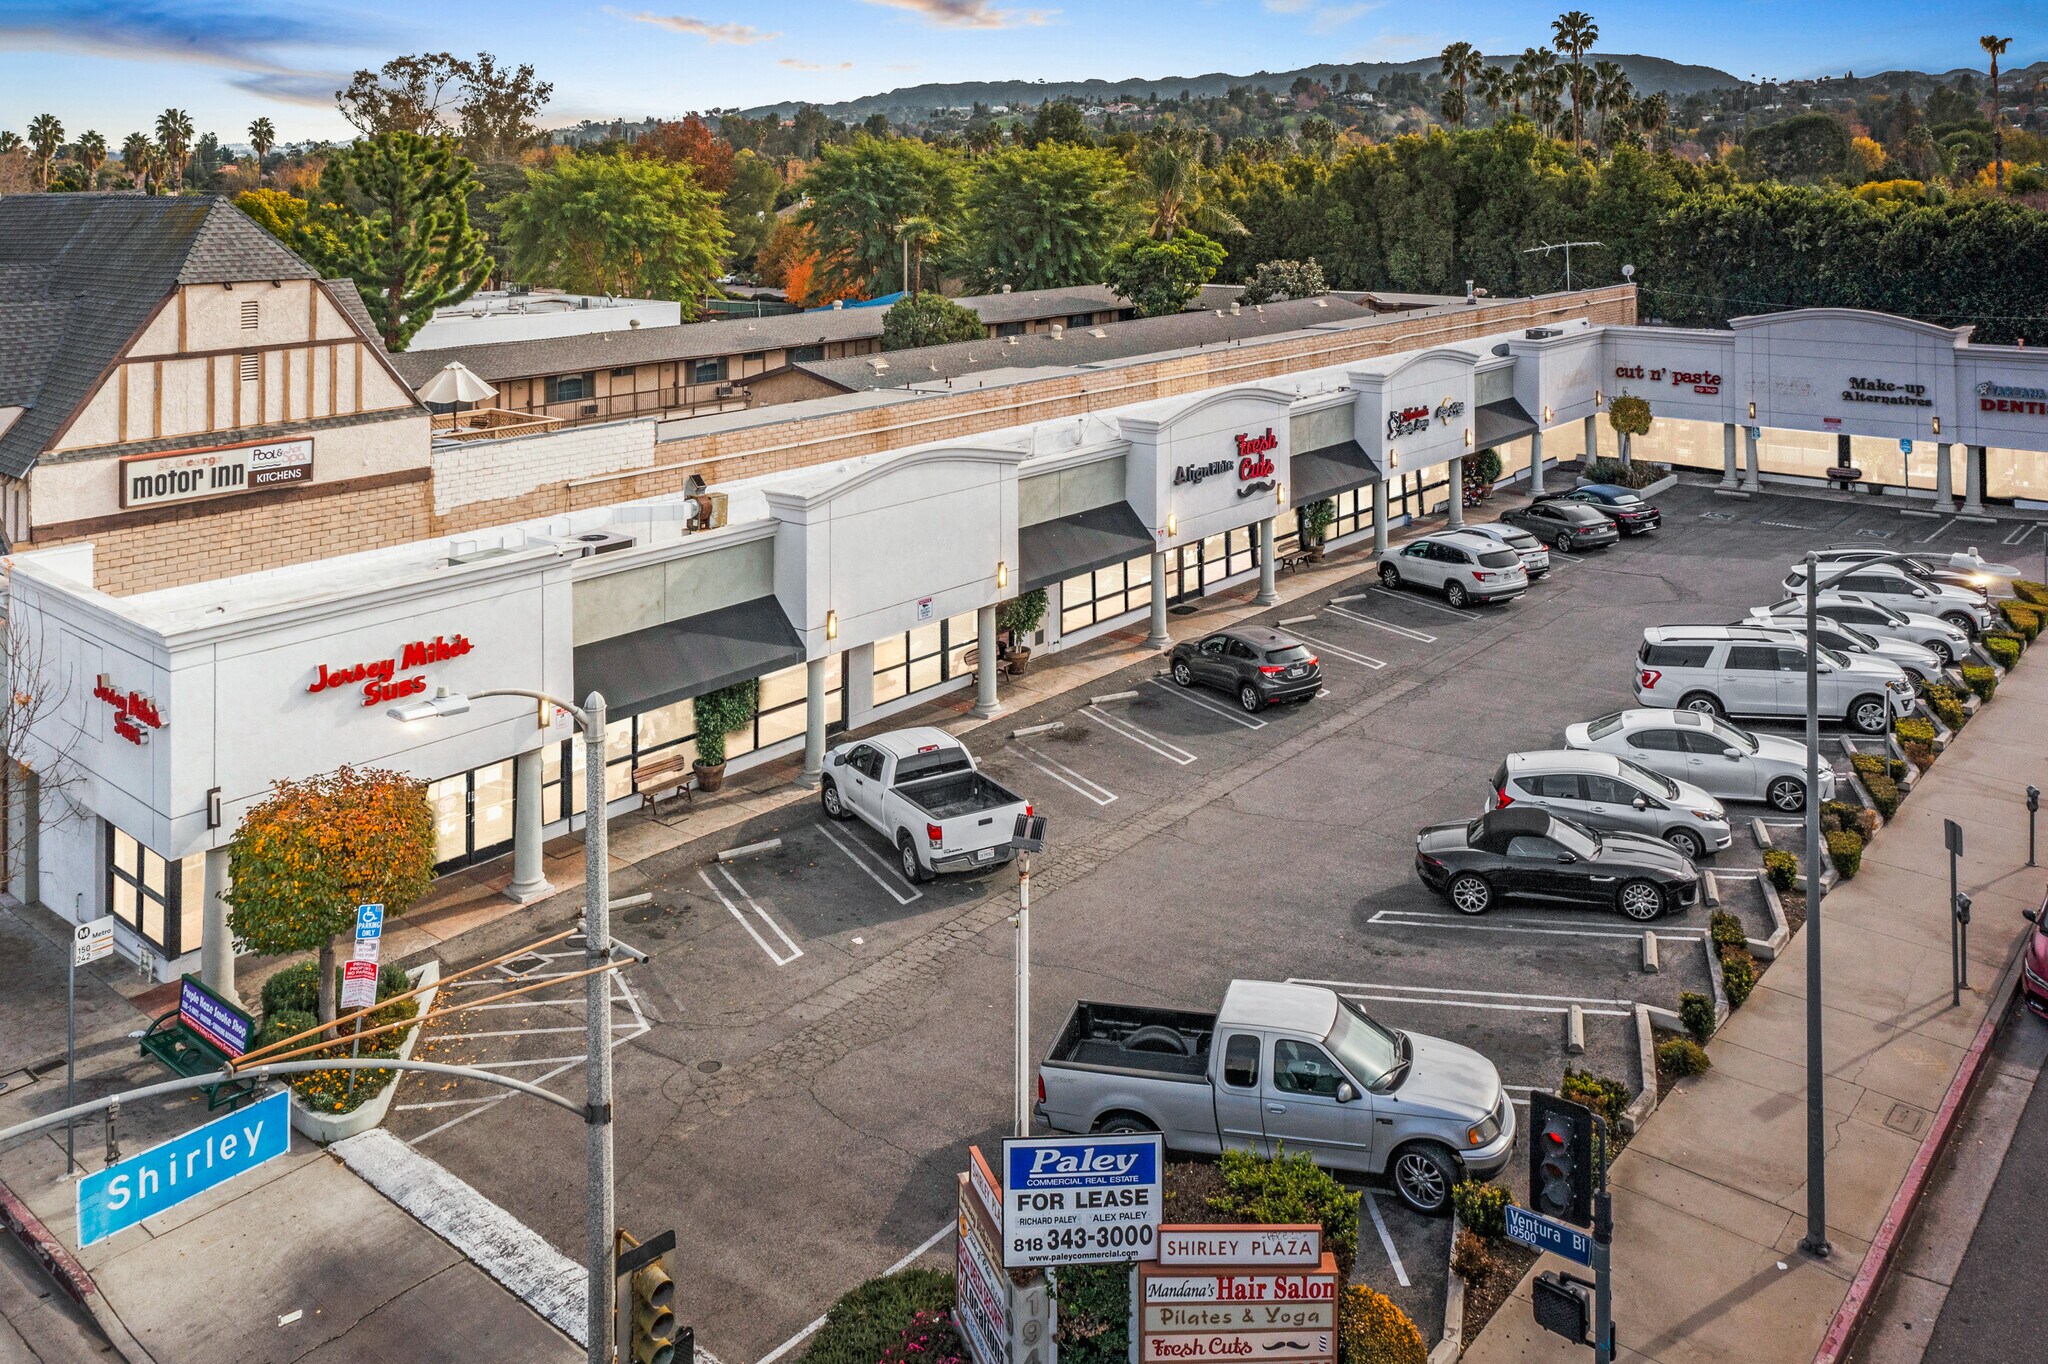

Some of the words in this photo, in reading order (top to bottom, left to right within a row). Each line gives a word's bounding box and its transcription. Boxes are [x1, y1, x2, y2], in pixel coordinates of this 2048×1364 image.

[1615, 365, 1644, 380] cut
[1671, 371, 1722, 386] paste
[1849, 377, 1925, 398] Make-up
[1841, 391, 1932, 407] Alternatives
[1234, 427, 1278, 457] Fresh
[276, 448, 284, 458] &
[282, 450, 307, 468] Spa
[256, 468, 302, 484] KITCHENS
[1239, 453, 1275, 481] Cuts
[133, 467, 204, 500] motor
[211, 463, 244, 489] inn
[308, 659, 395, 693] Jersey
[400, 634, 475, 671] Mike's
[92, 928, 112, 939] Metro
[361, 929, 376, 937] ONLY
[77, 953, 91, 964] 242
[78, 944, 91, 955] 150
[183, 984, 200, 1005] Purple
[199, 996, 214, 1014] Haze
[213, 1006, 232, 1027] Smoke
[231, 1018, 247, 1039] Shop
[106, 1120, 264, 1210] Shirley
[1029, 1148, 1139, 1178] Paley
[1027, 1177, 1083, 1187] COMMERCIAL
[1085, 1176, 1107, 1185] REAL
[1110, 1175, 1139, 1183] ESTATE
[1017, 1192, 1065, 1212] FOR
[1075, 1188, 1149, 1209] LEASE
[1019, 1216, 1053, 1226] RICHARD
[1054, 1215, 1078, 1225] PALEY
[1092, 1212, 1117, 1222] ALEX
[1119, 1211, 1148, 1221] PALEY
[1013, 1237, 1044, 1252] 818
[1047, 1223, 1153, 1251] 343-3000
[1510, 1209, 1561, 1244] Ventura
[1573, 1234, 1586, 1253] Bl
[1510, 1224, 1537, 1244] 19500
[1028, 1249, 1139, 1263] www.paleycommercial.com
[1167, 1240, 1239, 1256] SHIRLEY
[1252, 1241, 1312, 1256] PLAZA
[1148, 1279, 1214, 1298] Mandana's
[1216, 1275, 1267, 1300] Hair
[1274, 1275, 1334, 1299] Salon
[1160, 1307, 1232, 1325] Pilates
[1242, 1308, 1255, 1323] &
[1265, 1306, 1320, 1326] Yoga
[1152, 1337, 1206, 1357] Fresh
[1209, 1336, 1253, 1355] Cuts
